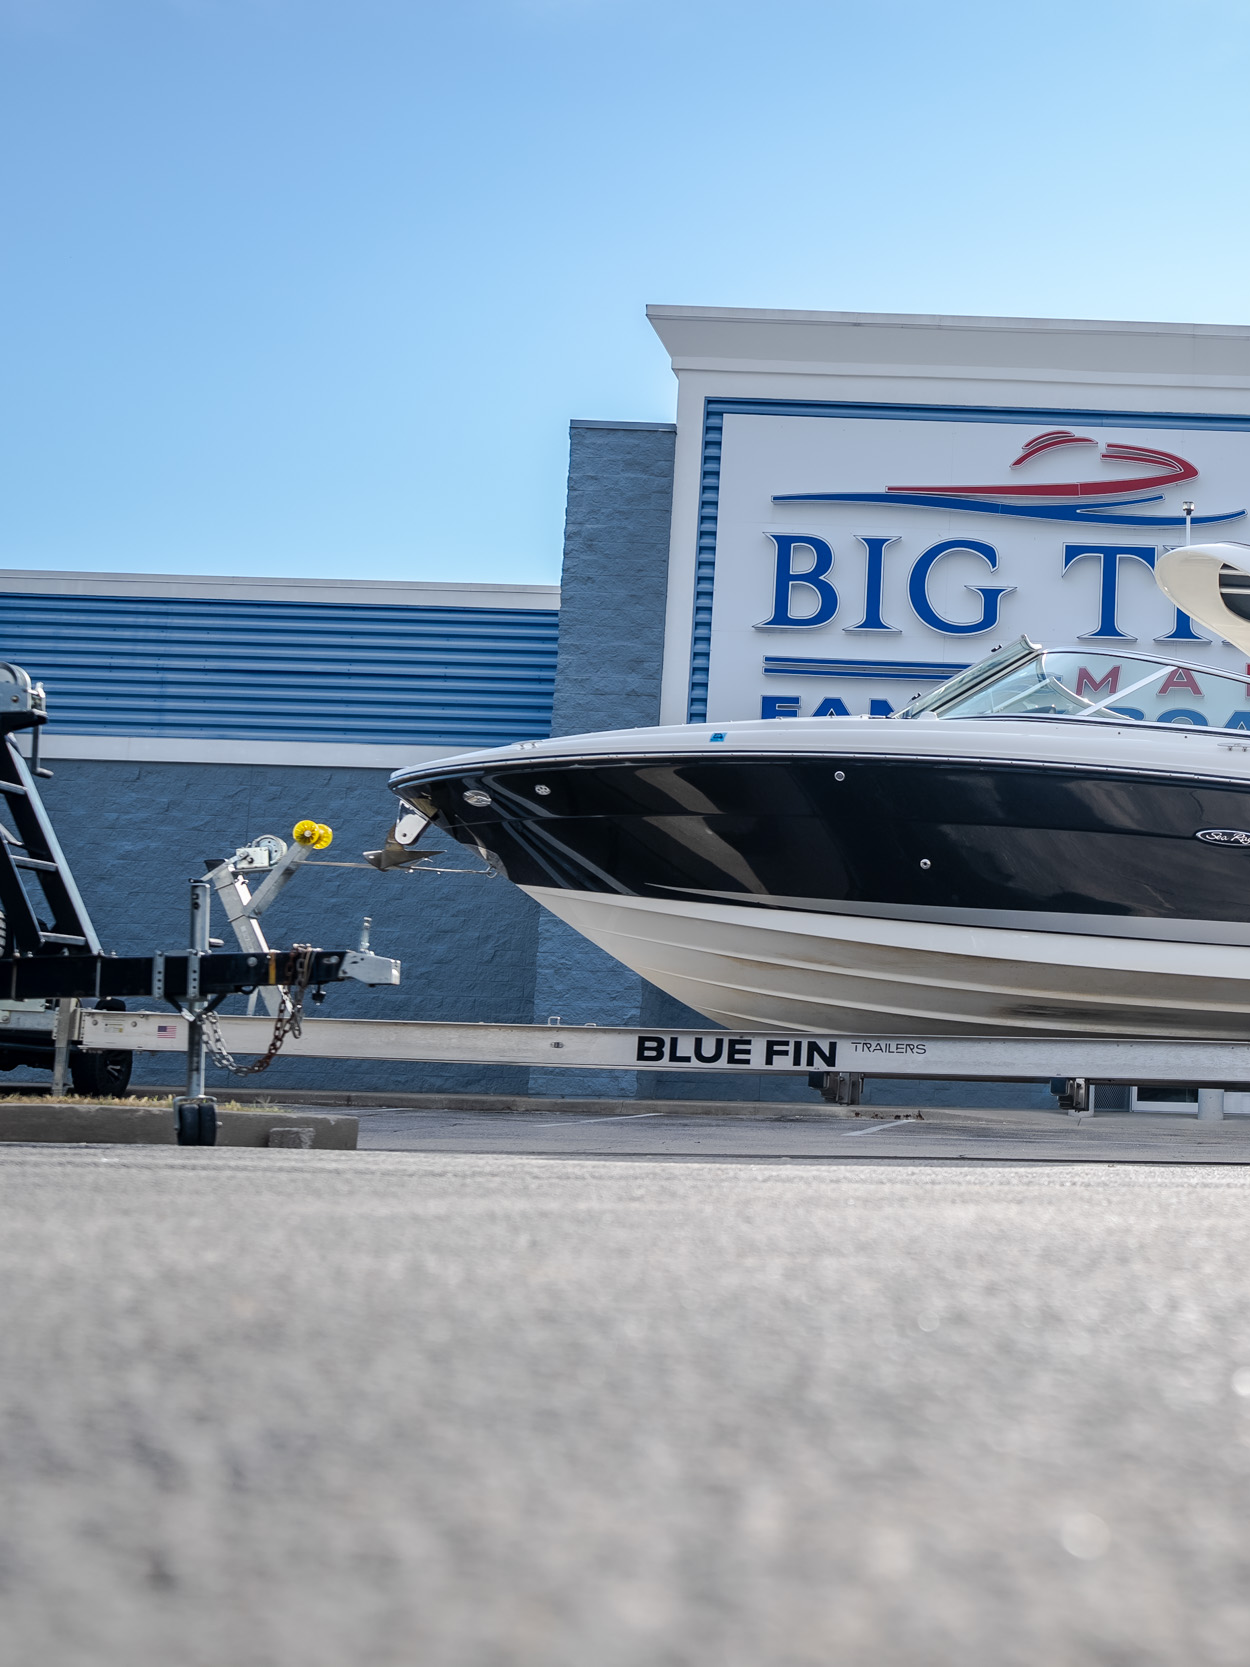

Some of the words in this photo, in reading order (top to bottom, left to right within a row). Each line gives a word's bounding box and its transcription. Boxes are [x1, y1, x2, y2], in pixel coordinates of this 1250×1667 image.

[752, 531, 1018, 637] BIG
[1206, 830, 1229, 841] Sea
[636, 1035, 752, 1065] BLUE
[764, 1039, 838, 1068] FIN
[850, 1041, 927, 1055] TRAILERS
